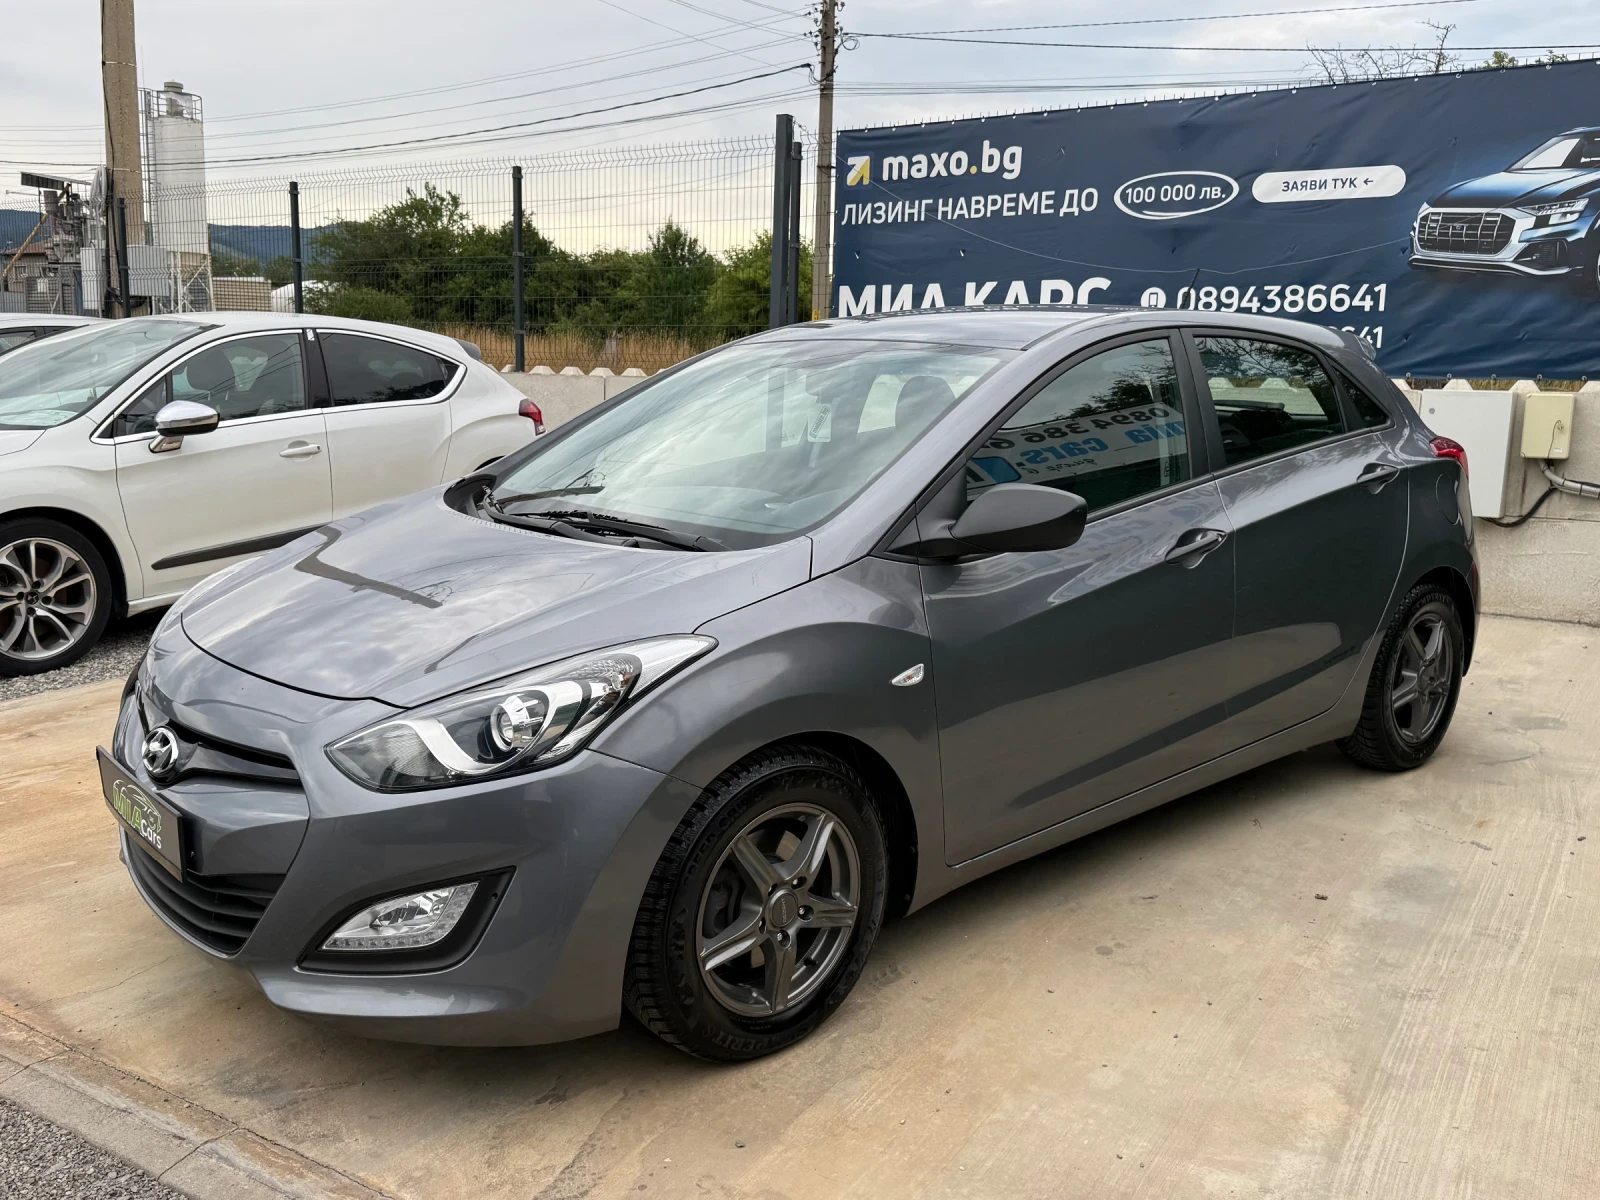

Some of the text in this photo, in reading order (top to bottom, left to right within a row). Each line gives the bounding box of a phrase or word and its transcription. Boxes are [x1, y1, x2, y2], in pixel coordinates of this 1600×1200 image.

[882, 139, 1023, 181] maxo.bg
[1281, 177, 1358, 192] ЗАЯВИ ТУК
[841, 184, 1226, 226] ЛИЗИНГ НАВРЕМЕ ДО 100 000 лв.
[1177, 283, 1387, 313] 0894386641
[141, 818, 162, 849] Cars
